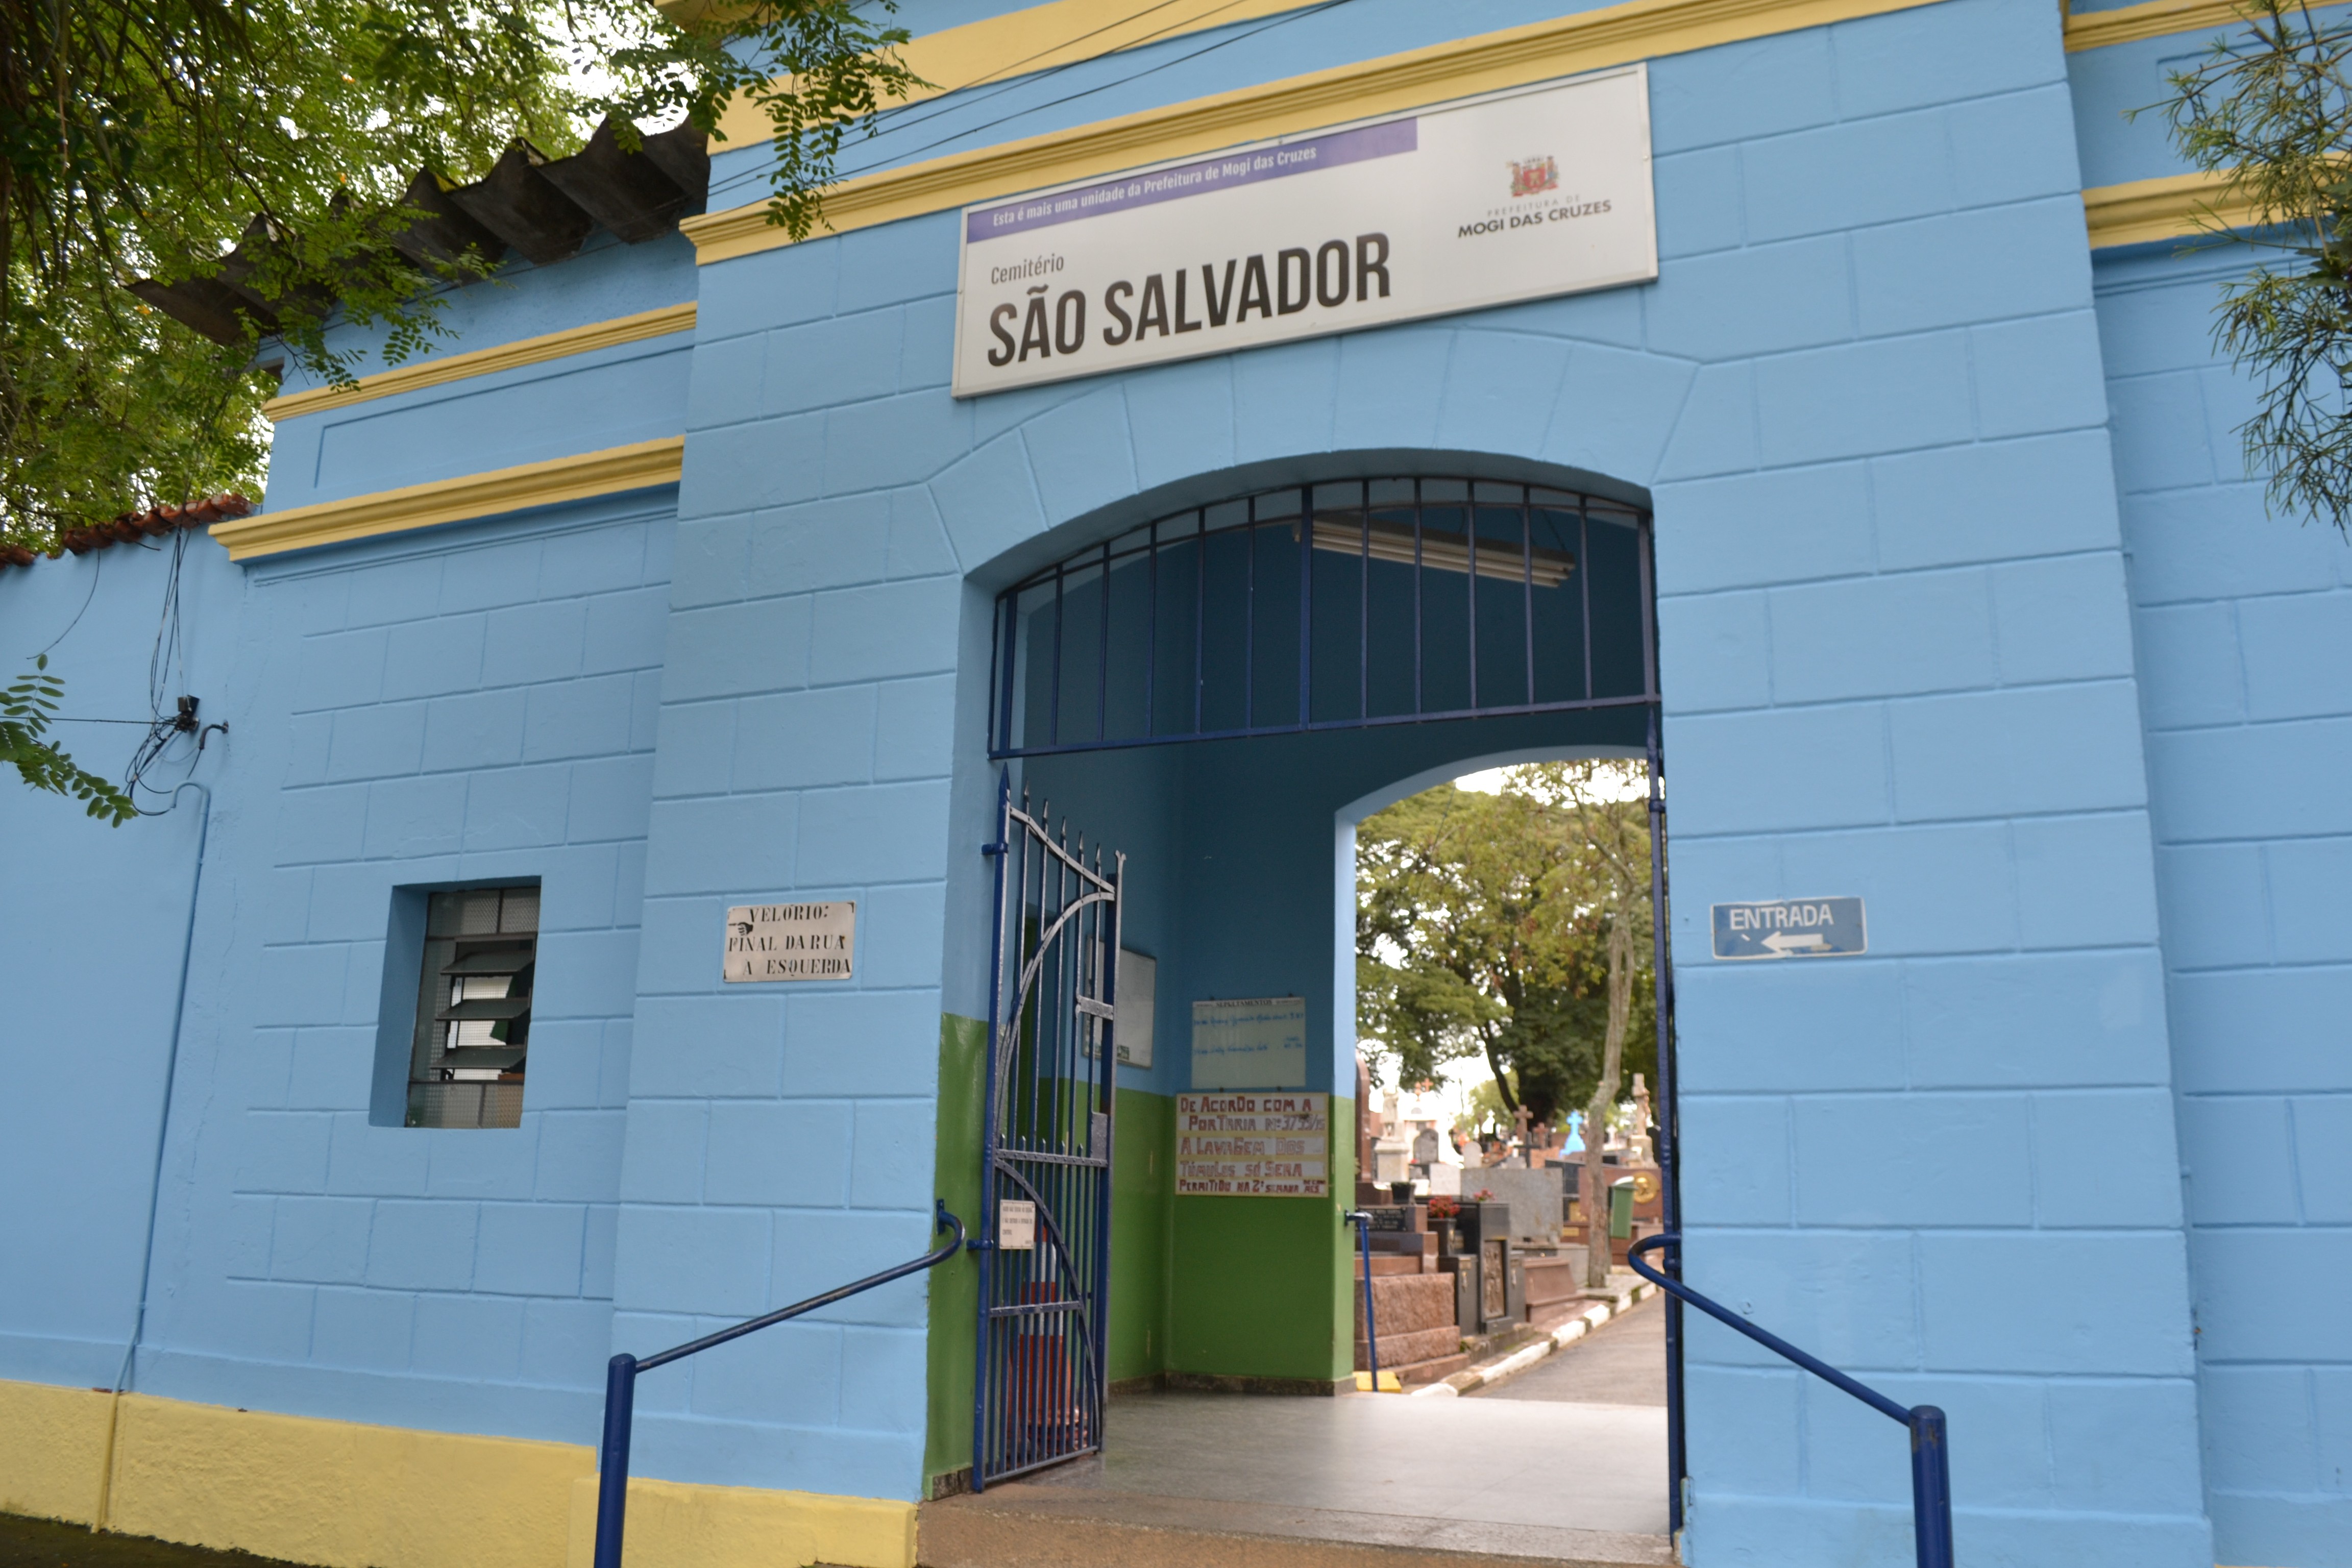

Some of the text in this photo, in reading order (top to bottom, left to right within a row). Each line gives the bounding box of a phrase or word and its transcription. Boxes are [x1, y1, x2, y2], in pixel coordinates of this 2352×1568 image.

[993, 146, 1317, 227] Esta é mais uma unidade da Prefeitura de Mogi das Cruzes
[1487, 194, 1580, 217] PREFEITURA DE
[1458, 199, 1612, 238] MOGI DAS CRUZES
[991, 253, 1065, 285] Cemitério
[988, 232, 1391, 367] SÃO SALVADOR
[1729, 903, 1835, 931] ENTRADA
[728, 934, 845, 952] FINAL DA RUA
[766, 958, 851, 976] ESQUERDA
[1263, 1098, 1295, 1112] COM
[1302, 1098, 1312, 1112] A
[1180, 1137, 1191, 1155] A
